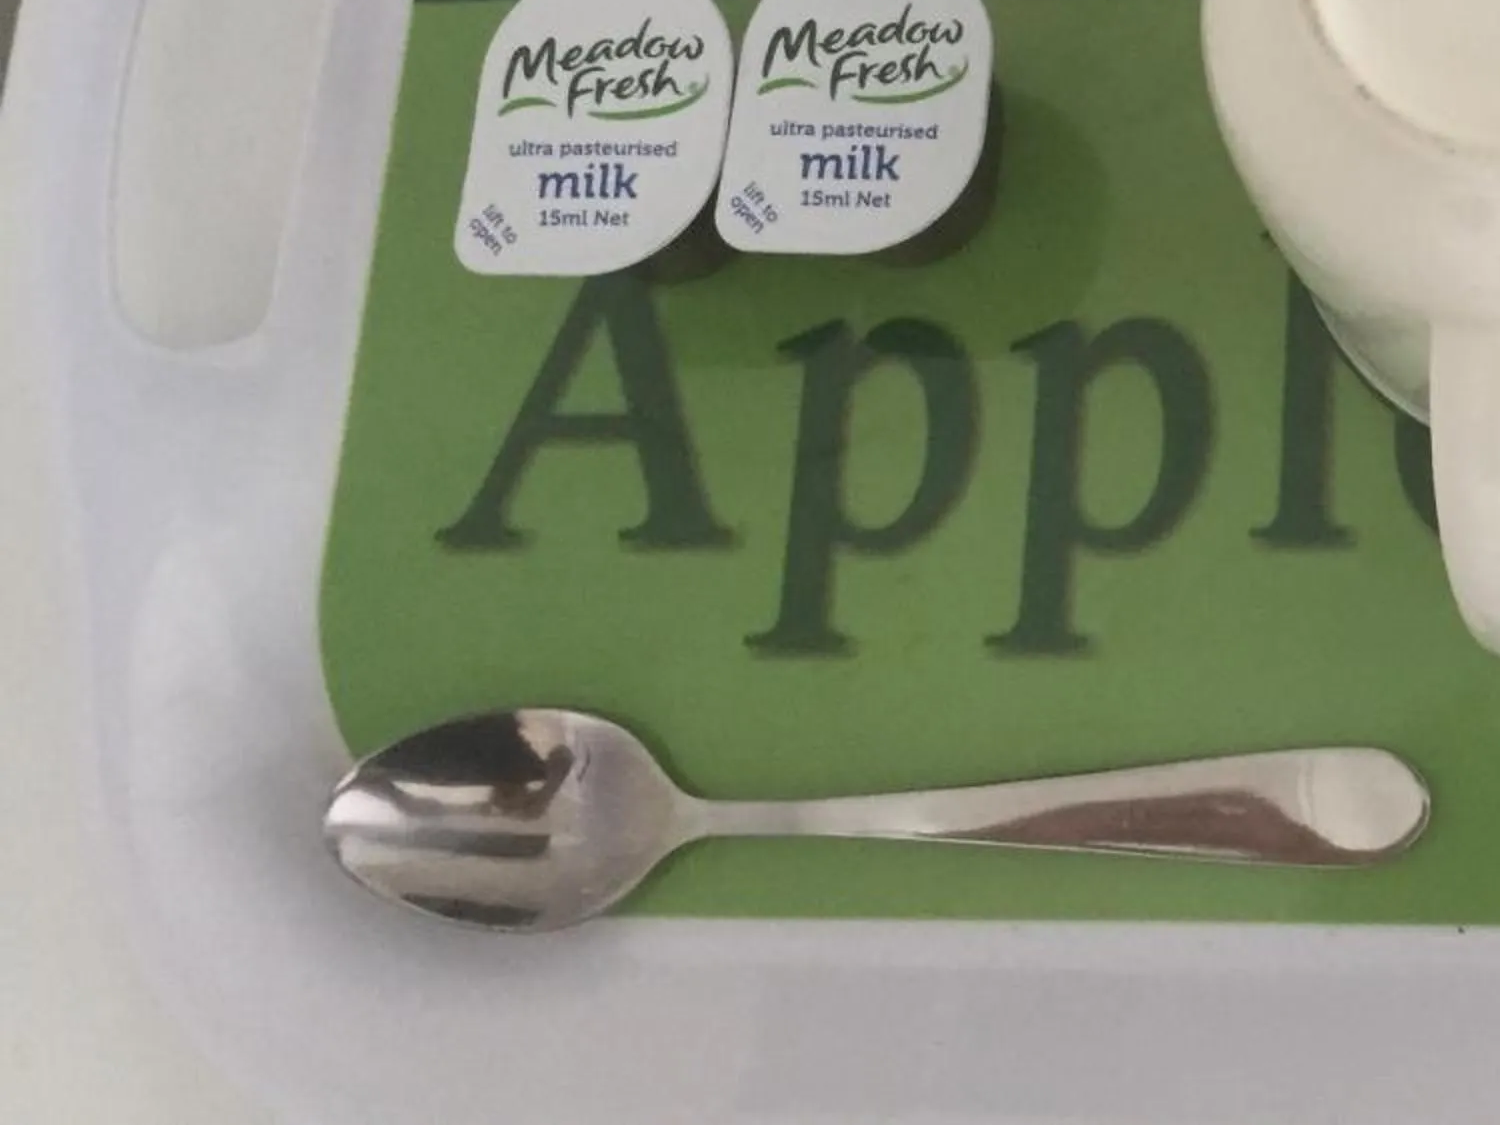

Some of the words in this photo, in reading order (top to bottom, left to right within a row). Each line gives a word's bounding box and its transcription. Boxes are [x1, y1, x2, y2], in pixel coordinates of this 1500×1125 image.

[502, 16, 705, 100] Meadow
[762, 3, 964, 79] Meadow
[566, 58, 684, 119] Fresh
[828, 43, 944, 102] Fresh
[508, 139, 553, 158] ultra
[559, 139, 678, 159] pasteurised
[769, 119, 816, 137] ultra
[821, 120, 939, 141] pasteurised
[536, 162, 639, 200] milk
[800, 144, 900, 182] milk
[538, 209, 588, 227] 15ml
[592, 209, 630, 227] Net
[730, 195, 765, 235] open
[743, 180, 767, 207] lift
[763, 201, 779, 224] to
[800, 189, 850, 207] 15ml
[855, 190, 892, 209] Net
[468, 218, 502, 257] open
[482, 203, 505, 228] lift
[502, 225, 518, 245] to
[434, 231, 1440, 655] Appl
